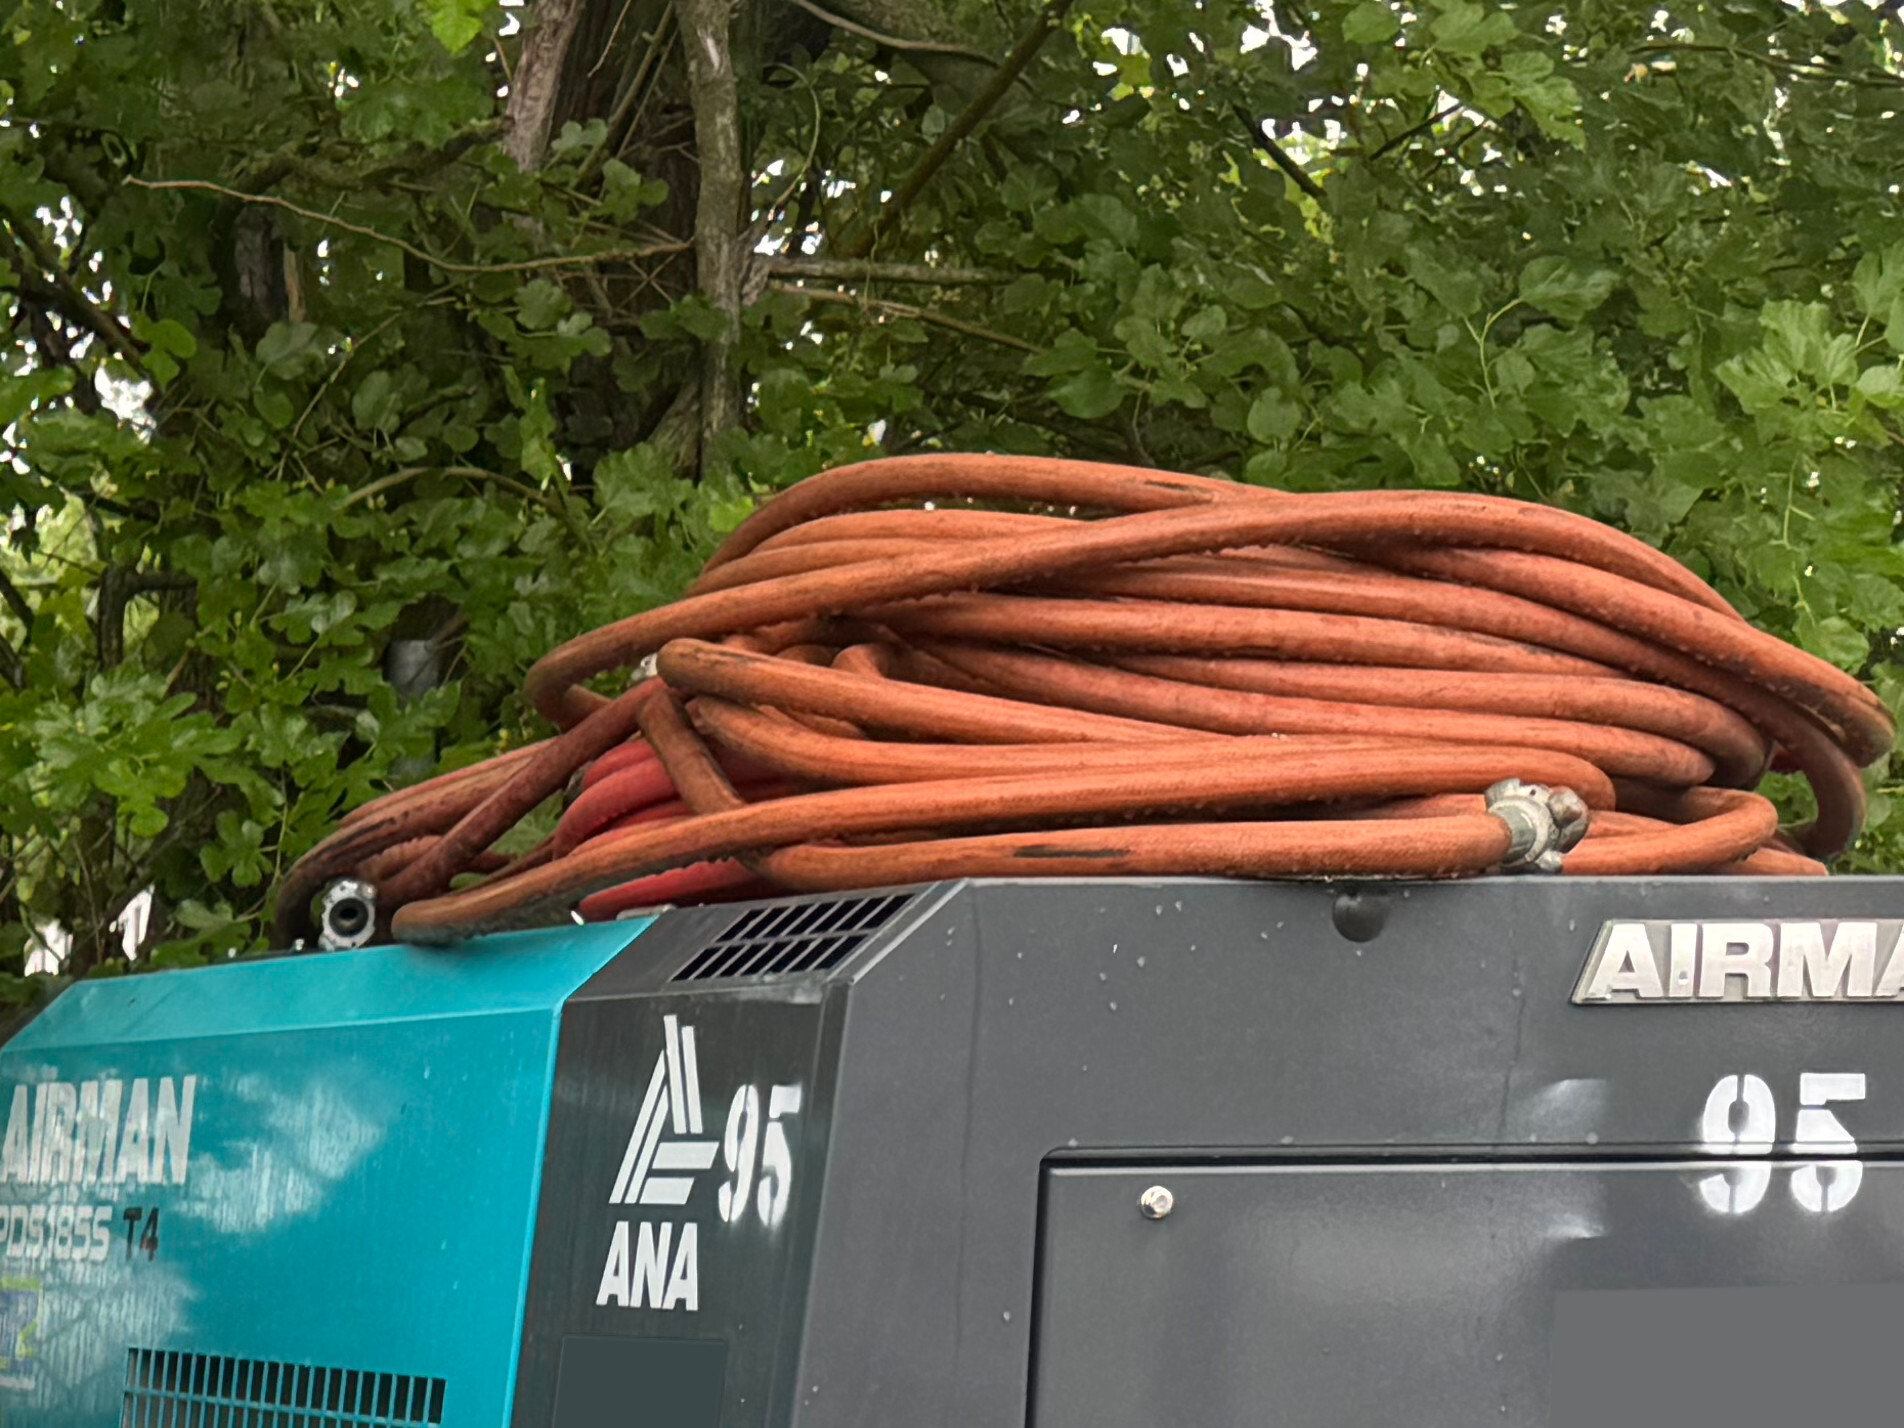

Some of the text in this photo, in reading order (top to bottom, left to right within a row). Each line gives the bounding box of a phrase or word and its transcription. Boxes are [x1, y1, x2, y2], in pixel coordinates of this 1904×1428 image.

[718, 1085, 801, 1228] 95
[1699, 1073, 1866, 1214] 95
[123, 1207, 159, 1262] T4
[596, 1221, 698, 1311] ANA
